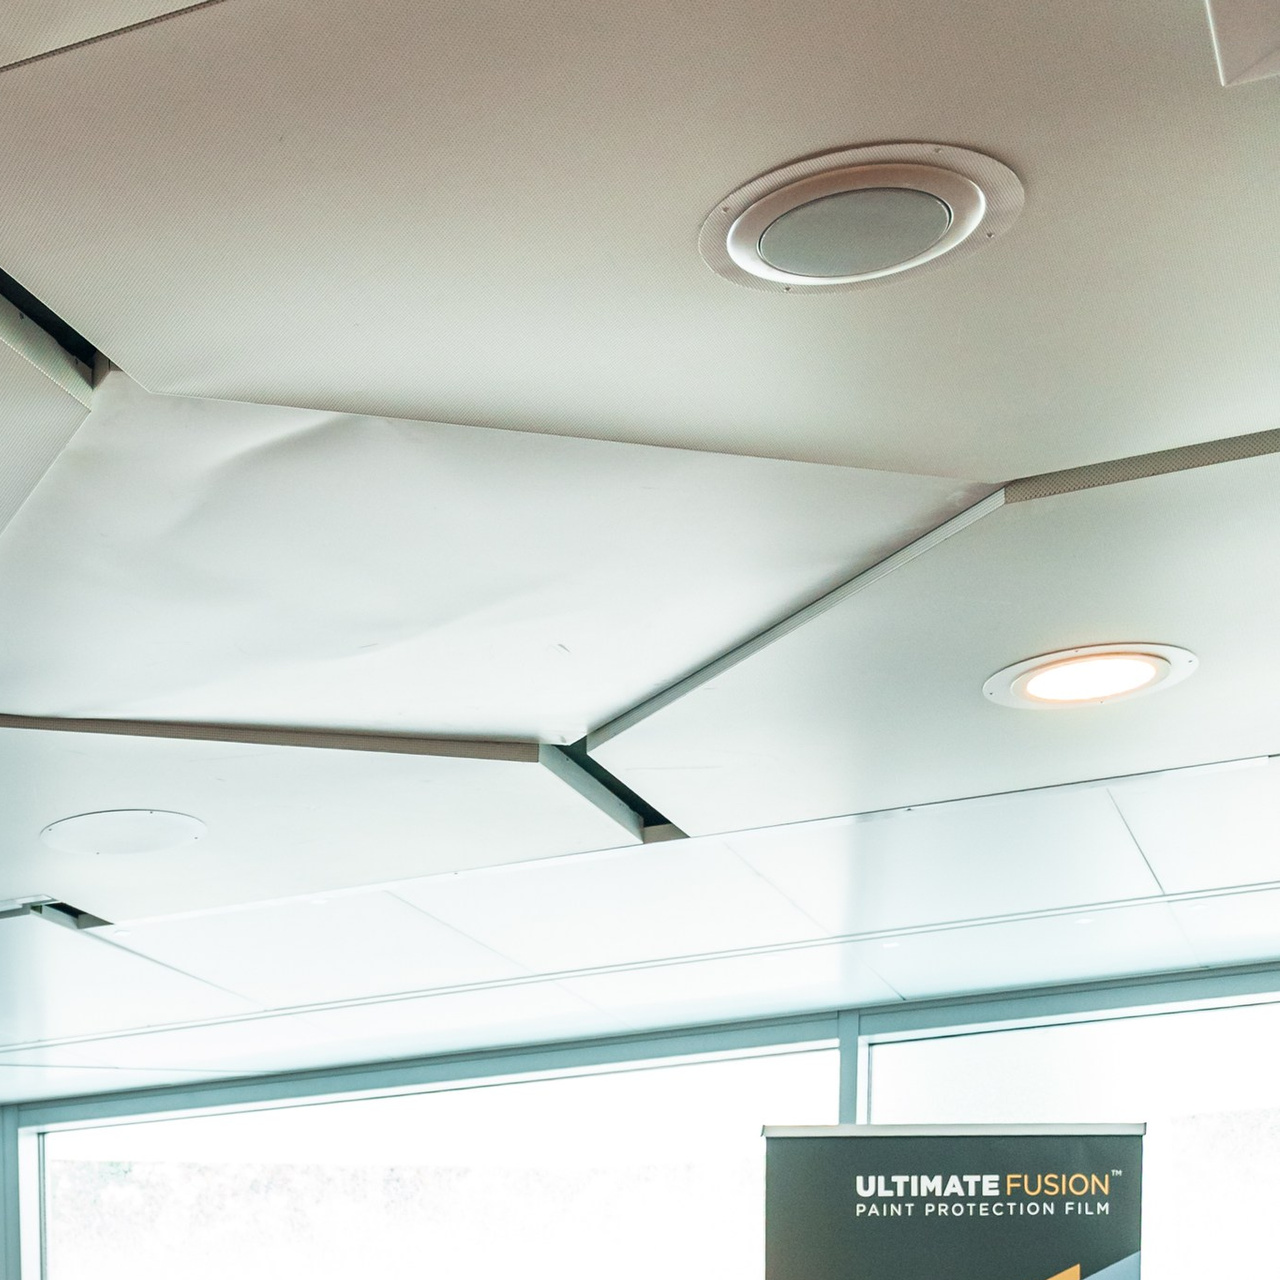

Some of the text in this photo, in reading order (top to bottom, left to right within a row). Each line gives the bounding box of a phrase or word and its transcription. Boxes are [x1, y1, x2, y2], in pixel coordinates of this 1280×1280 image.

[856, 1175, 1000, 1198] ULTIMATE
[856, 1201, 1110, 1217] PAINT PROTECTION FILM
